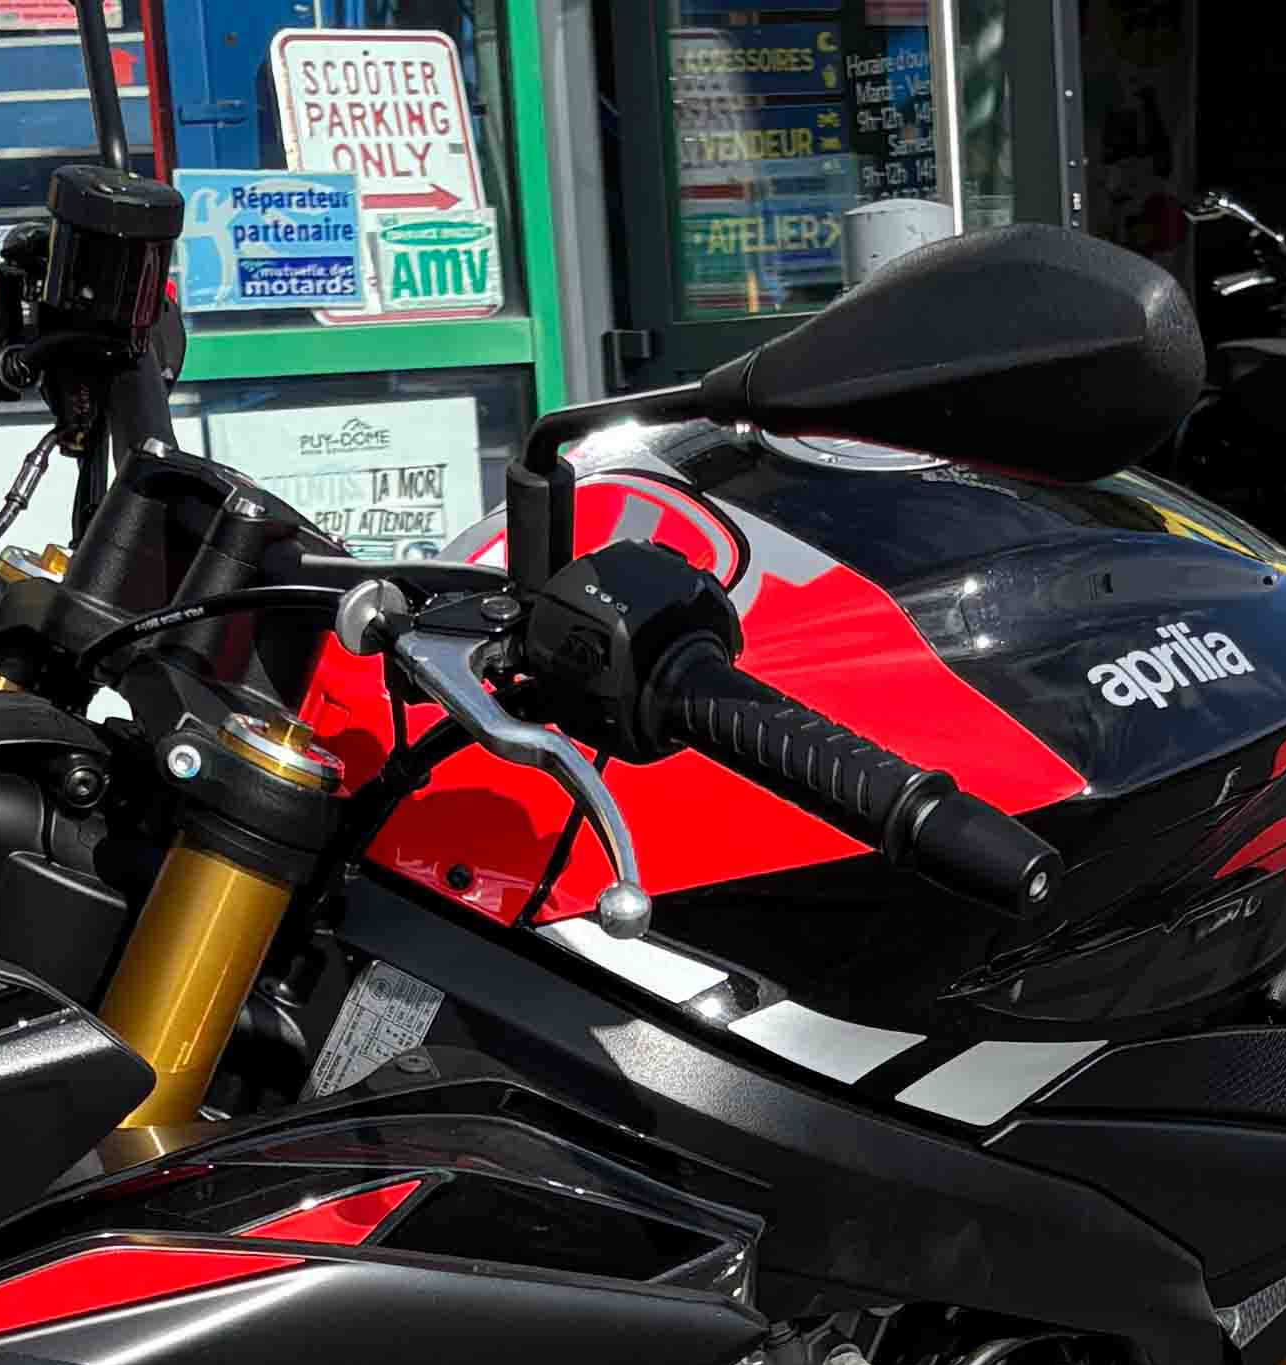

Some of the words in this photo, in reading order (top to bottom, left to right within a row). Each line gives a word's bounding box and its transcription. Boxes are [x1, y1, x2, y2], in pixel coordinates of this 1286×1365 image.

[682, 48, 814, 74] ACCESSOIRES
[302, 60, 439, 96] SCOOTER
[304, 101, 450, 138] PARKING
[331, 142, 432, 177] ONLY
[233, 186, 350, 213] Réparateur
[233, 218, 354, 249] partenaire
[707, 215, 820, 255] ATELIER
[245, 276, 355, 295] motards
[358, 508, 437, 536] ATTENDRE
[1086, 621, 1256, 709] aprilia
